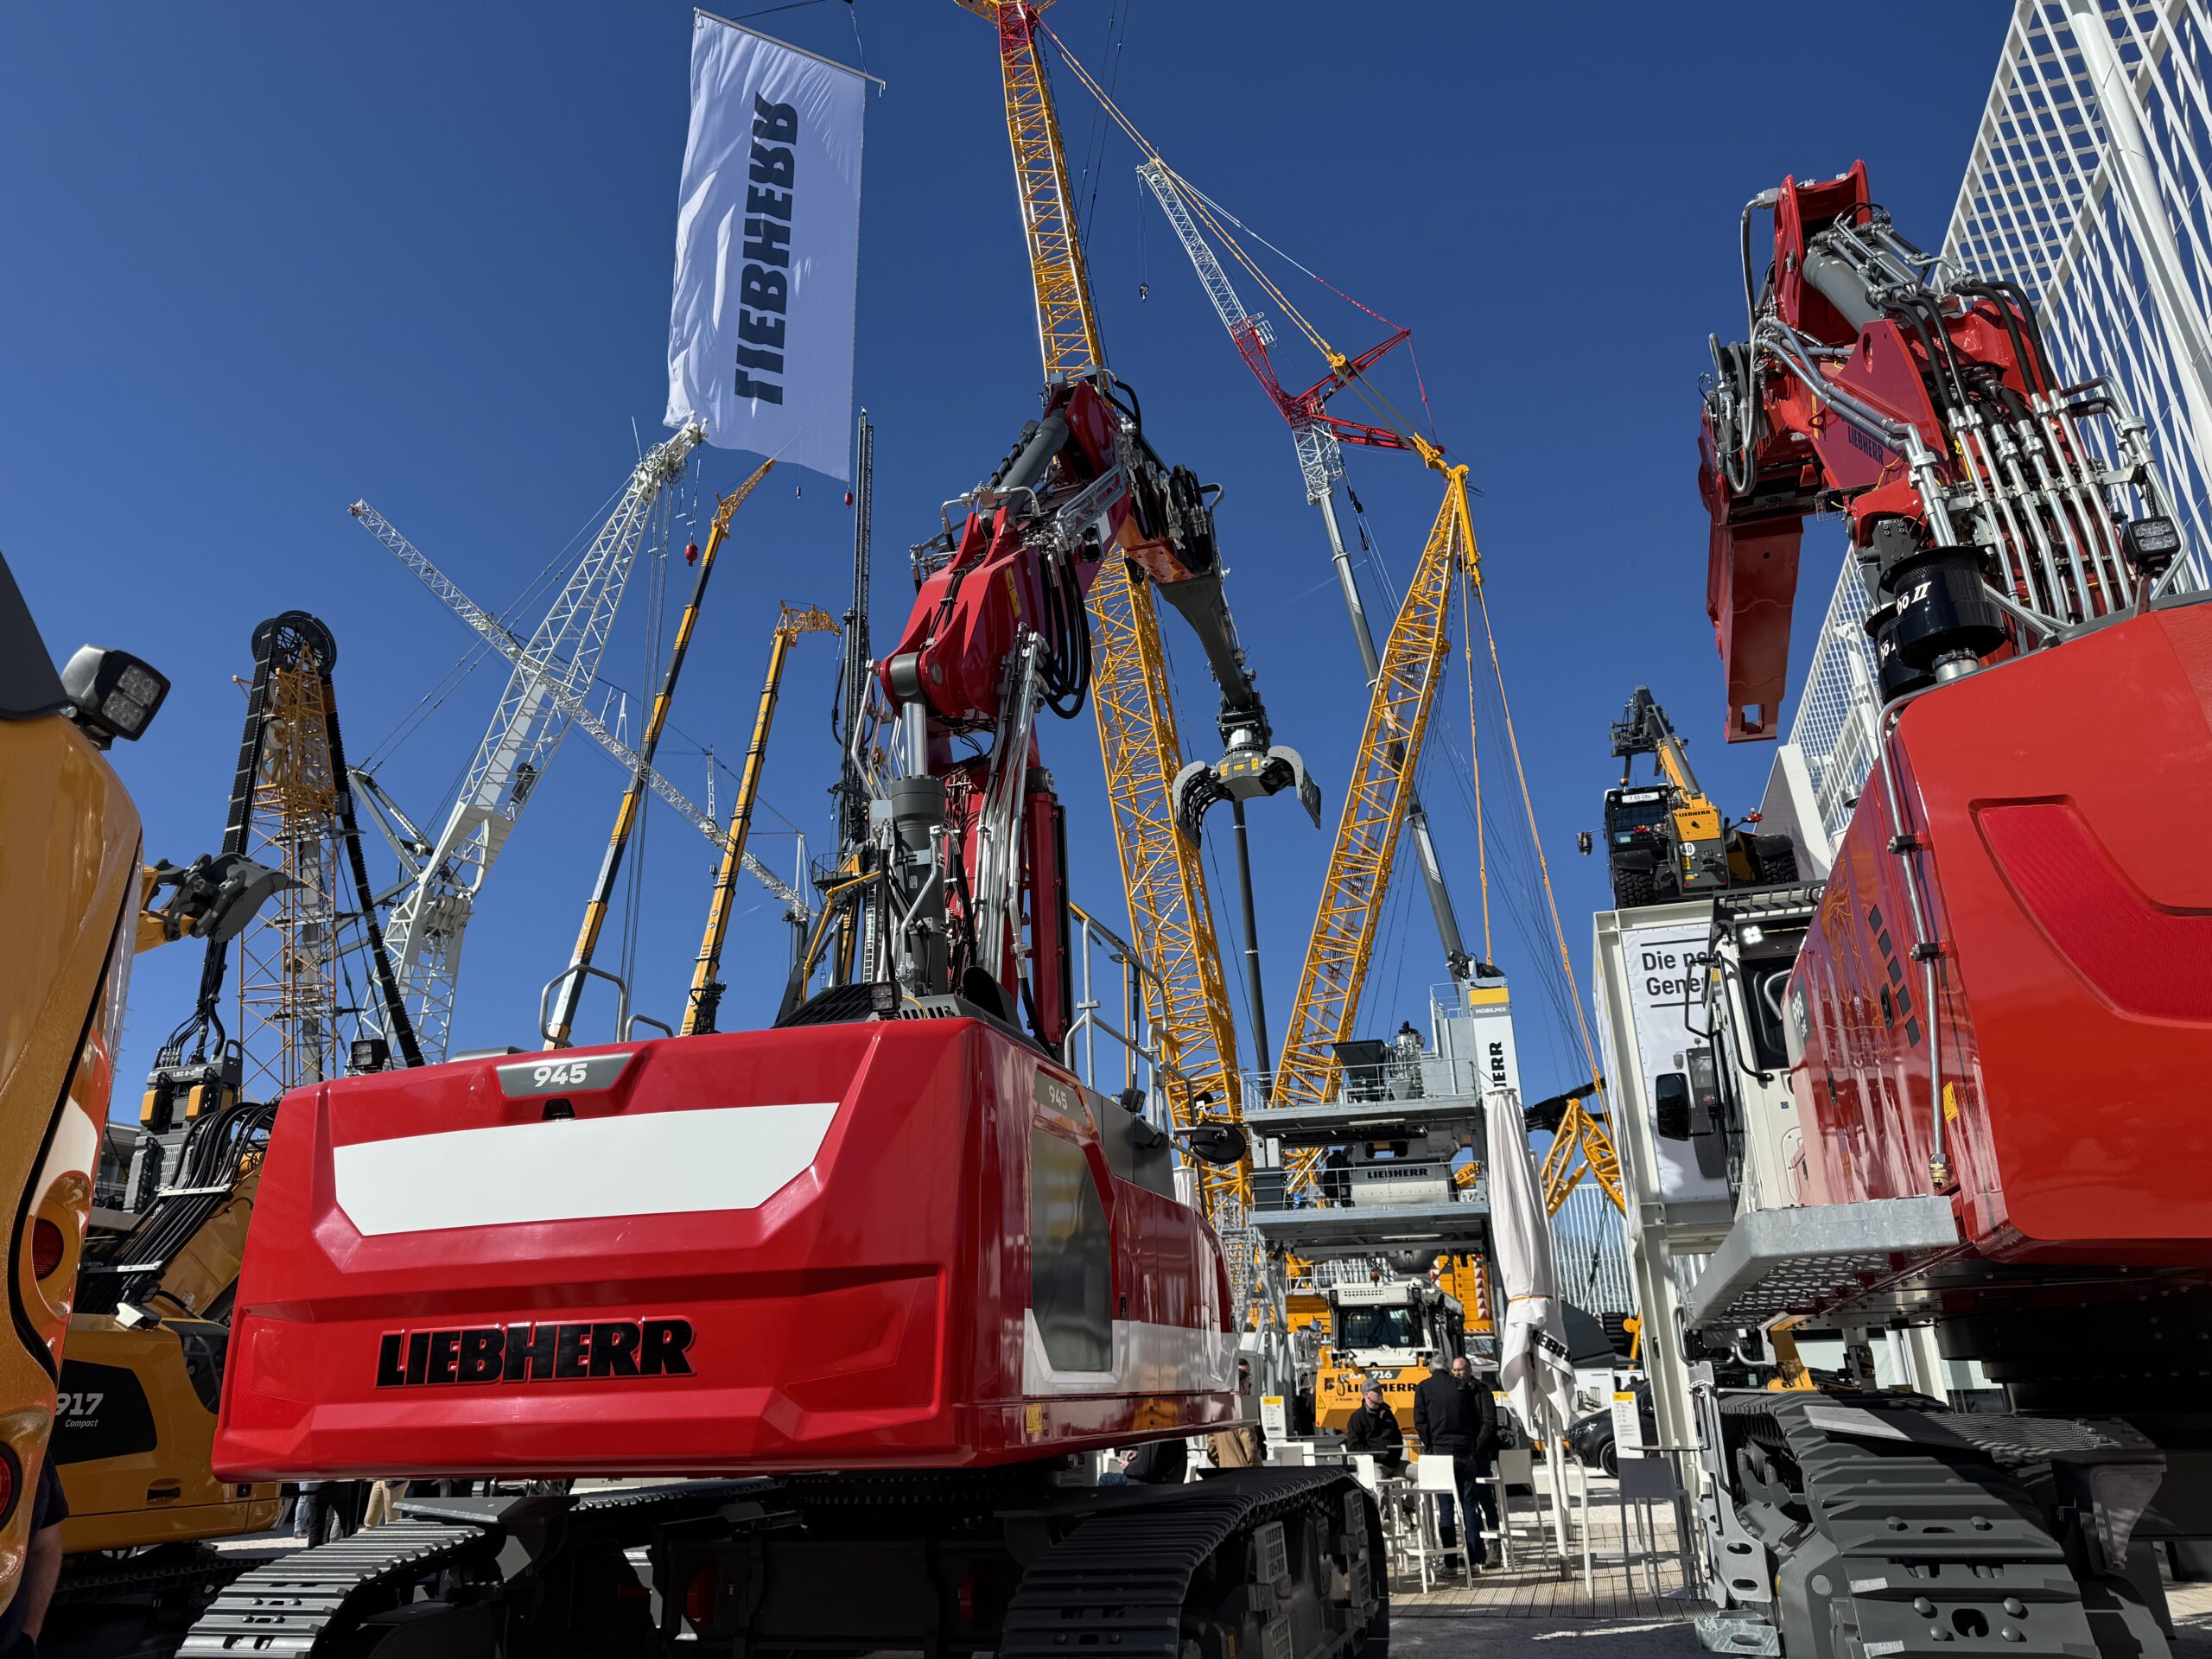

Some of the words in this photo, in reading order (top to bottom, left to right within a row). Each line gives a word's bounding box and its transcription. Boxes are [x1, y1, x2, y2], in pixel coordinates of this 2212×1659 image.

[1847, 425, 1884, 466] LIEBHERR
[1642, 951, 1676, 971] Die
[533, 1063, 588, 1087] 945
[1048, 1084, 1068, 1110] 945
[1367, 1168, 1428, 1179] LIEBHERR
[376, 1318, 695, 1388] LIEBHERR
[1371, 1370, 1393, 1379] 716
[55, 1393, 104, 1415] 917
[65, 1419, 99, 1429] Compact
